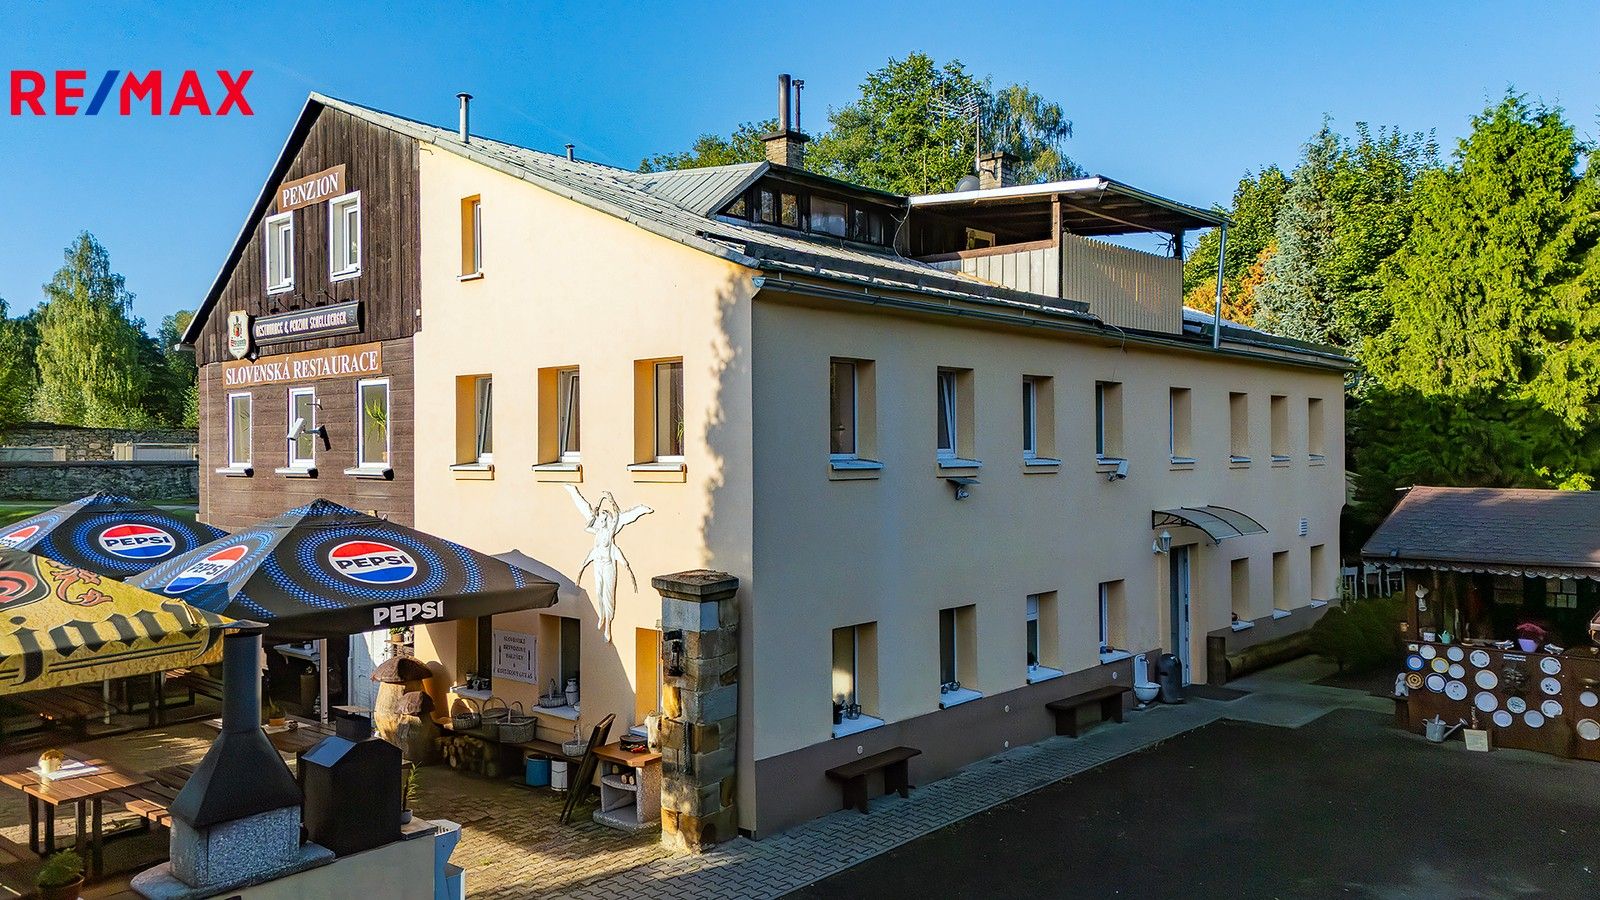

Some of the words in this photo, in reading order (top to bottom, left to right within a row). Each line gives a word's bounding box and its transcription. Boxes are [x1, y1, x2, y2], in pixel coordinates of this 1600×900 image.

[282, 171, 339, 208] PENZION
[225, 357, 291, 385] SLOVENSKÁ
[293, 350, 379, 379] RESTAURACE
[104, 535, 171, 547] PEPSI
[188, 561, 228, 576] PEPSI
[334, 554, 410, 570] PEPSI
[372, 600, 444, 626] PEPSI
